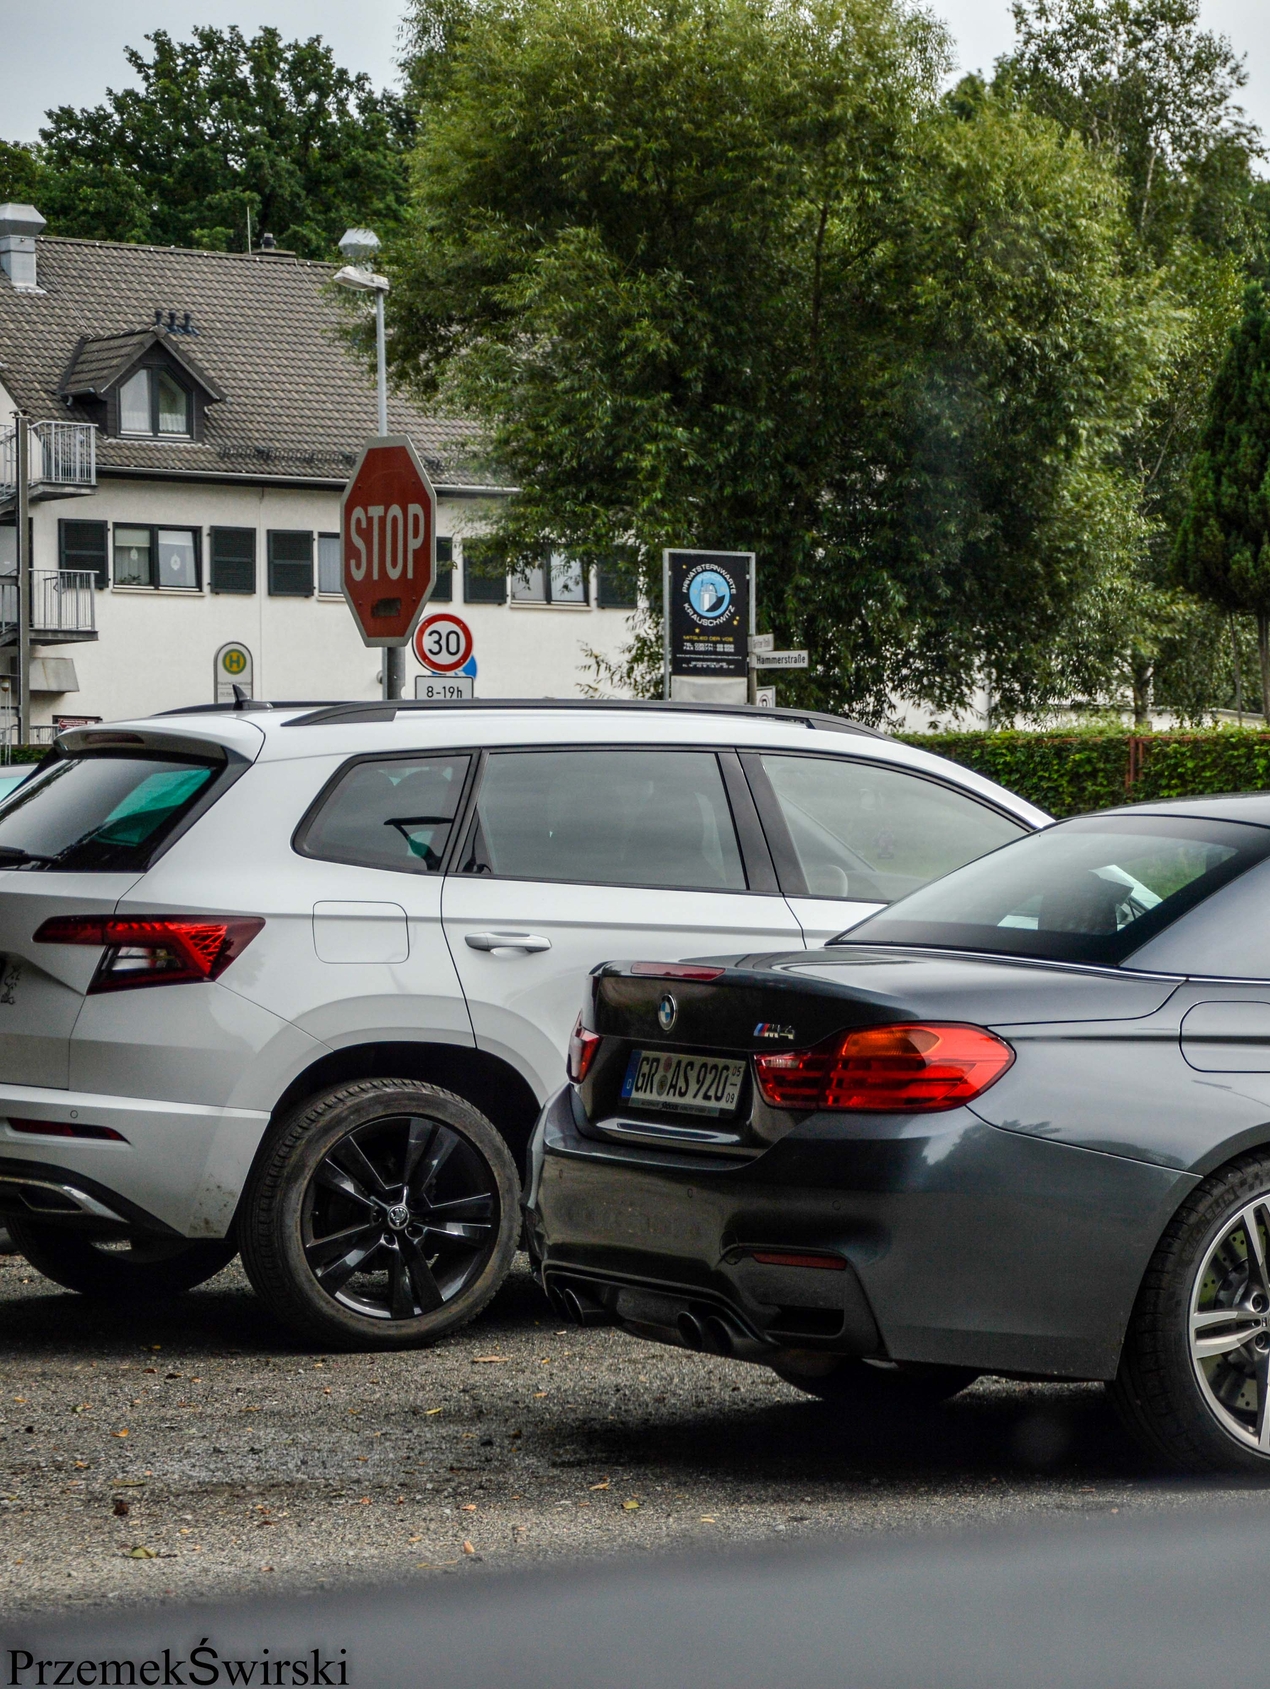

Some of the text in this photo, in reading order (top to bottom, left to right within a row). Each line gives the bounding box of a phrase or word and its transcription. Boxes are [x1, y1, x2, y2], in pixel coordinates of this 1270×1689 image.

[350, 503, 425, 581] STOP
[682, 563, 737, 595] PRIVATSTERNWARTE
[683, 602, 736, 627] KRAUSCHWITZ
[427, 630, 460, 656] 30
[229, 654, 241, 669] H
[756, 653, 806, 665] Hammerstraße
[634, 1056, 730, 1102] GR AS 920
[725, 1092, 735, 1104] 09
